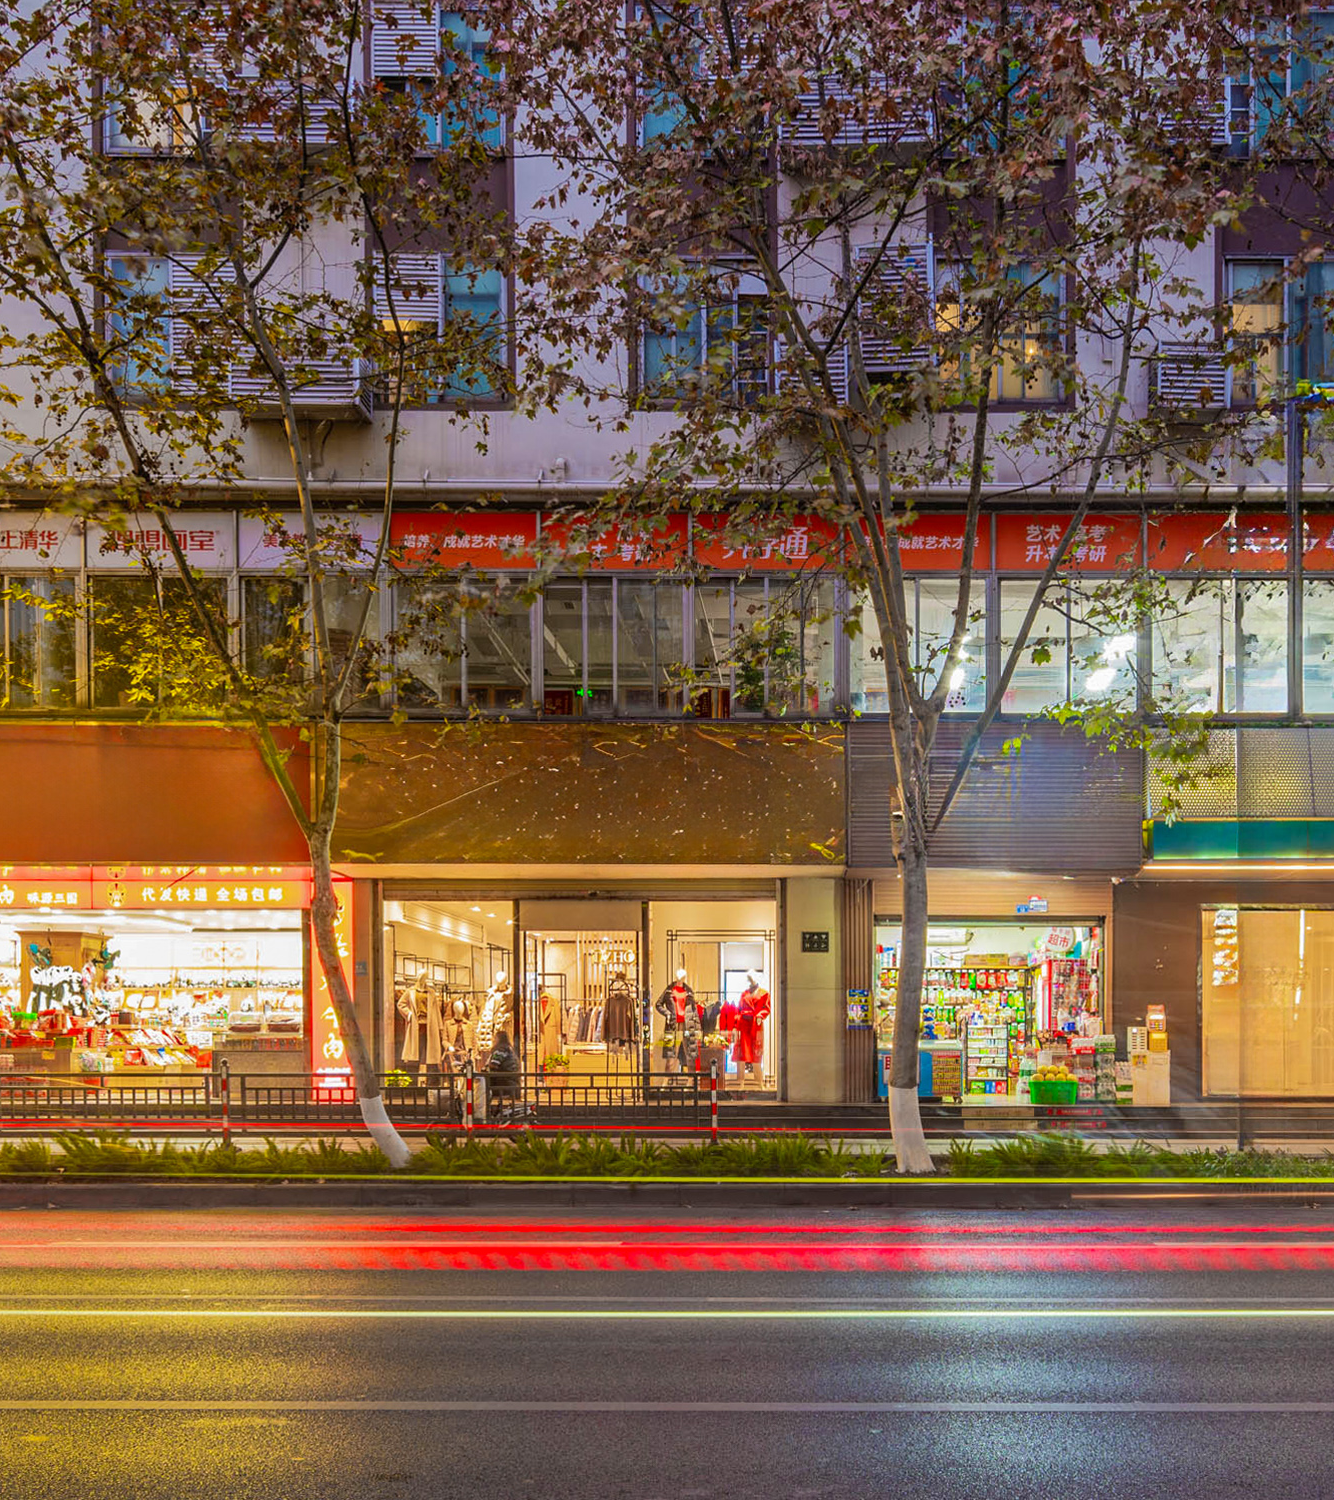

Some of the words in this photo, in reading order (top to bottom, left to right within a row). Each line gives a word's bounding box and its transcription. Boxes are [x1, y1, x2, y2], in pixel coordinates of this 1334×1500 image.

[1025, 525, 1062, 542] 艺术
[216, 887, 283, 902] 全场包邮
